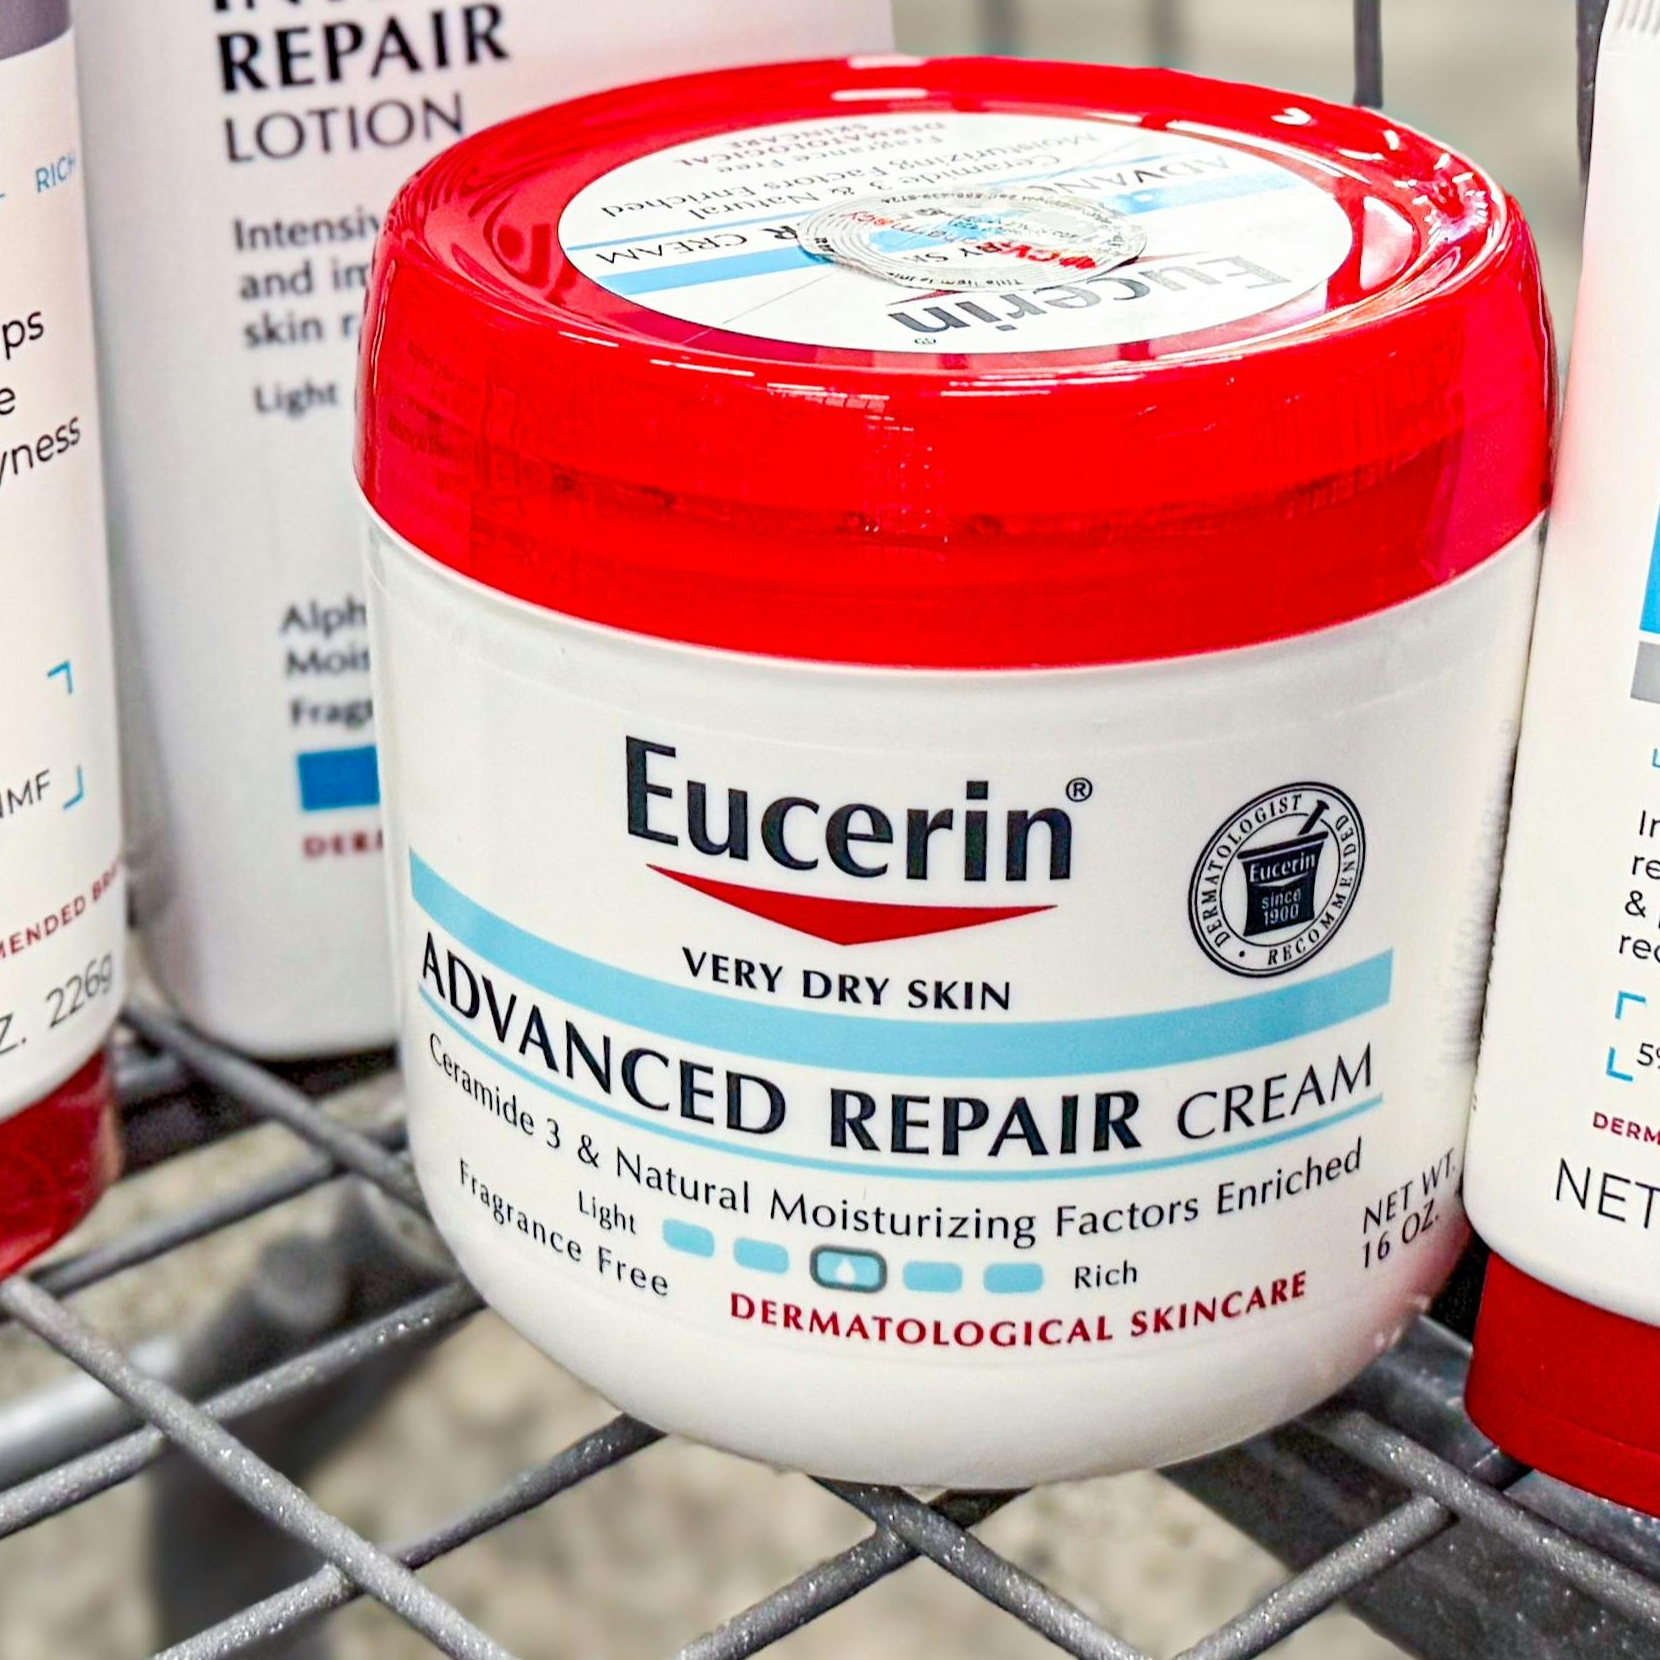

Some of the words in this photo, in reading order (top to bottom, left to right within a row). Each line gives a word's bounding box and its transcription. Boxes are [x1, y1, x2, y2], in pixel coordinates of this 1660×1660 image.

[217, 3, 508, 94] REPAIR
[225, 93, 464, 164] LOTION
[763, 165, 889, 190] Factors
[869, 180, 892, 190] 3
[902, 155, 1061, 186] Ceramide
[601, 185, 756, 218] Enriched
[688, 191, 821, 221] Natural
[831, 185, 855, 196] &
[596, 233, 748, 265] CREAM
[239, 259, 313, 300] and
[244, 312, 323, 348] skin
[254, 379, 337, 416] Light
[279, 595, 366, 637] Alph
[1202, 794, 1302, 948] DERMATOLOGIST
[1268, 814, 1356, 965] RECOMMENDED
[1250, 852, 1316, 883] Eucerin
[1262, 888, 1301, 910] since
[1264, 904, 1299, 926] 1900
[1624, 889, 1647, 918] &
[46, 950, 114, 1027] 226g
[683, 946, 783, 990] VERY
[802, 967, 889, 1007] DRY
[908, 977, 1010, 1011] SKIN
[422, 931, 787, 1136] ADVANCED
[829, 1088, 1142, 1157] REPAIR
[1177, 1042, 1372, 1140] CREAM
[428, 1031, 535, 1136] Ceramide
[546, 1120, 562, 1149] 3
[577, 1133, 601, 1168] &
[616, 1146, 750, 1215] Natural
[770, 1188, 1037, 1249] Moisturizing
[1055, 1194, 1200, 1238] Factors
[1216, 1136, 1363, 1216] Enriched
[1361, 1182, 1413, 1235] NET
[1422, 1148, 1457, 1195] WT.
[459, 1158, 583, 1262] Fragrance
[598, 1249, 668, 1297] Free
[578, 1190, 637, 1236] Light
[1361, 1232, 1391, 1269] 16
[1402, 1198, 1440, 1244] OZ.
[1074, 1260, 1138, 1289] Rich
[730, 1291, 1113, 1348] DERMATOLOGICAL
[1131, 1270, 1307, 1337] SKINCARE
